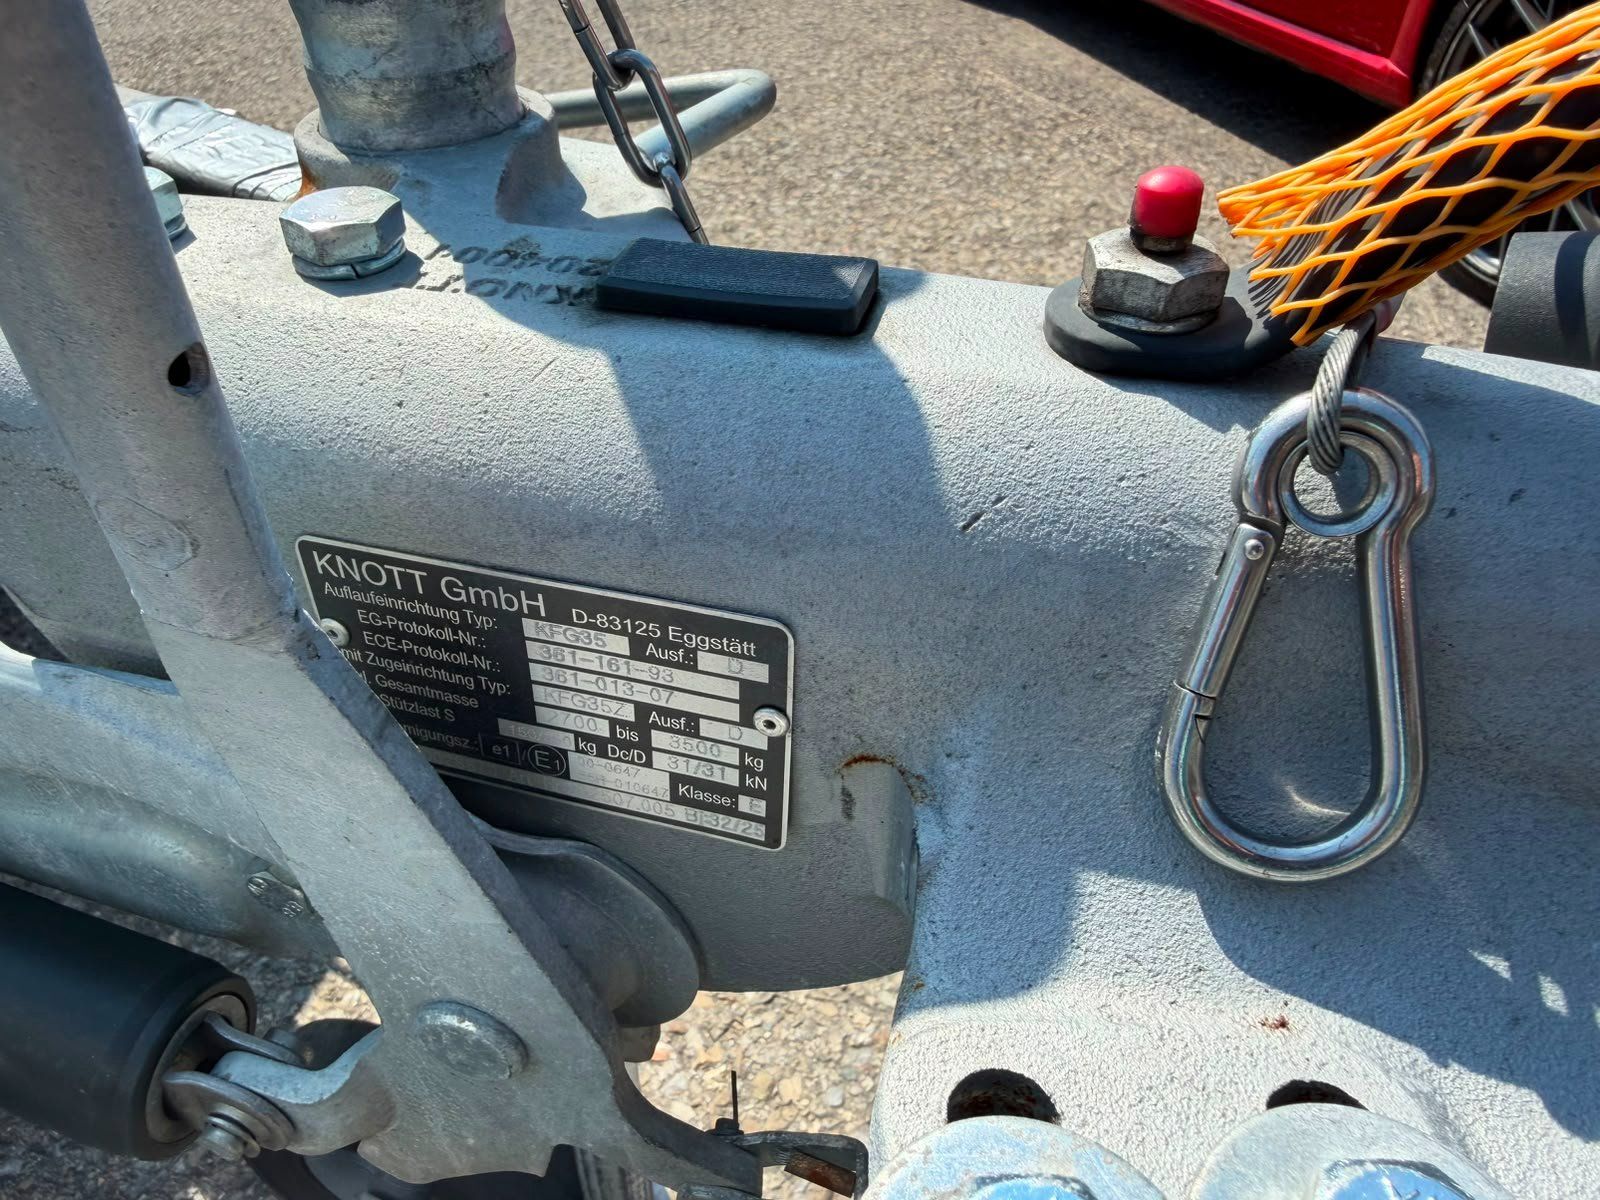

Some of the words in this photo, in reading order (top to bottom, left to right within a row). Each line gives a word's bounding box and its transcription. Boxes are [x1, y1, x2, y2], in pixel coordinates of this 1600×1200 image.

[313, 551, 427, 594] KNOTT
[440, 576, 546, 617] GmbH
[324, 581, 459, 625] Auflaufeinrichtung
[462, 609, 498, 630] Typ:
[535, 622, 608, 649] KFG35
[646, 642, 694, 665] Ausf.:
[357, 609, 486, 648] EG-Protokoll-Nr.:
[537, 646, 675, 684] 361-161-93
[572, 608, 661, 638] D-83125
[669, 626, 757, 658] Eggstätt
[363, 631, 501, 673] ECE-Protokoll-Nr.:
[543, 667, 675, 704] 361-013-07
[366, 651, 475, 690] Zugeinrichtung
[479, 676, 512, 696] Typ:
[648, 711, 696, 733] Ausf.:
[376, 674, 480, 709] Gesamtmasse
[616, 725, 640, 743] bis
[745, 752, 764, 771] kg
[379, 692, 442, 720] Stützlast
[445, 708, 456, 722] S
[578, 737, 597, 756] kg
[608, 744, 647, 765] Dc/D
[667, 755, 727, 781] 31/31
[745, 773, 768, 791] kN
[678, 783, 736, 809] Klasse:
